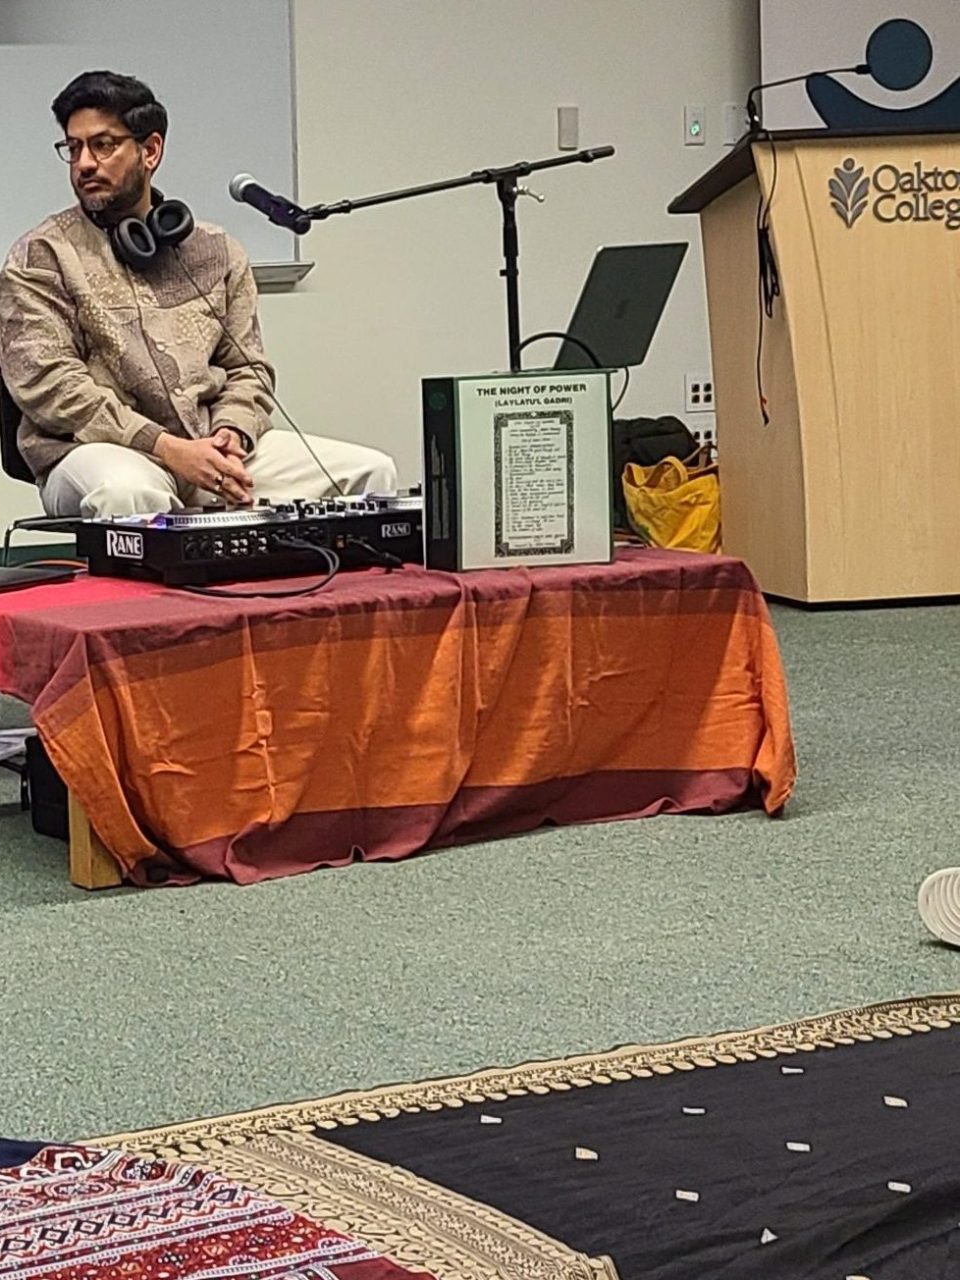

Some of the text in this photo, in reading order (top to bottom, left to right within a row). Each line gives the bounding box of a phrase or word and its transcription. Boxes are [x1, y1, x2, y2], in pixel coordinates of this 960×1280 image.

[872, 160, 960, 193] Oakto
[476, 383, 586, 396] THE NIGHT OF POWER
[106, 530, 142, 557] RANE
